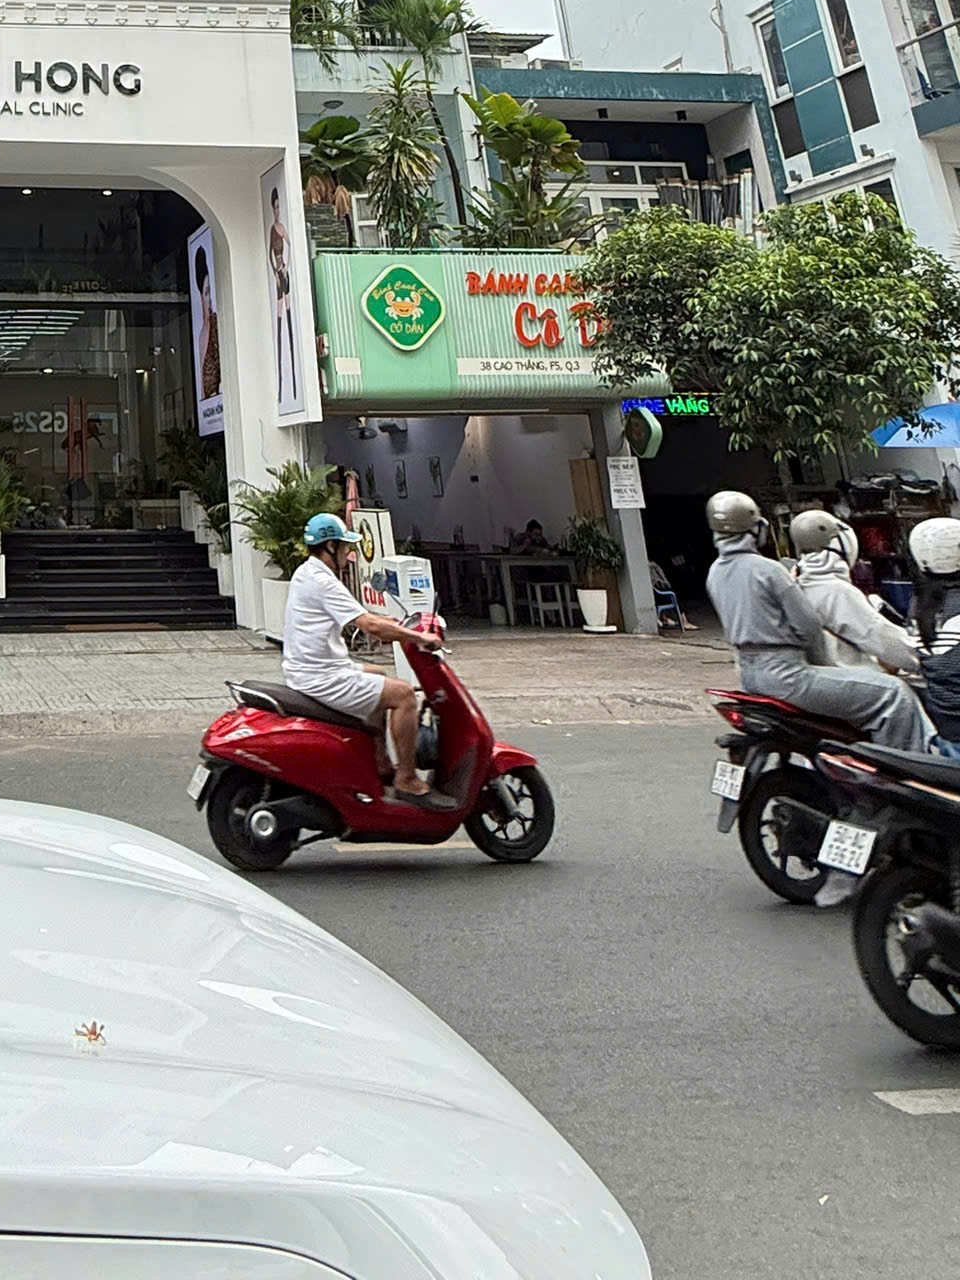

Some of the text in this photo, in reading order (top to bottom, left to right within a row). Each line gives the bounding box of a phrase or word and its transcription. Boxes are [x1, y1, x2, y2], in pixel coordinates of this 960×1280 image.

[14, 60, 142, 97] HONG
[28, 101, 84, 117] CLINIC
[466, 268, 529, 295] BÁNH
[514, 301, 565, 348] Cô
[480, 361, 491, 371] 38
[493, 361, 513, 371] CAO
[550, 361, 563, 372] F5,
